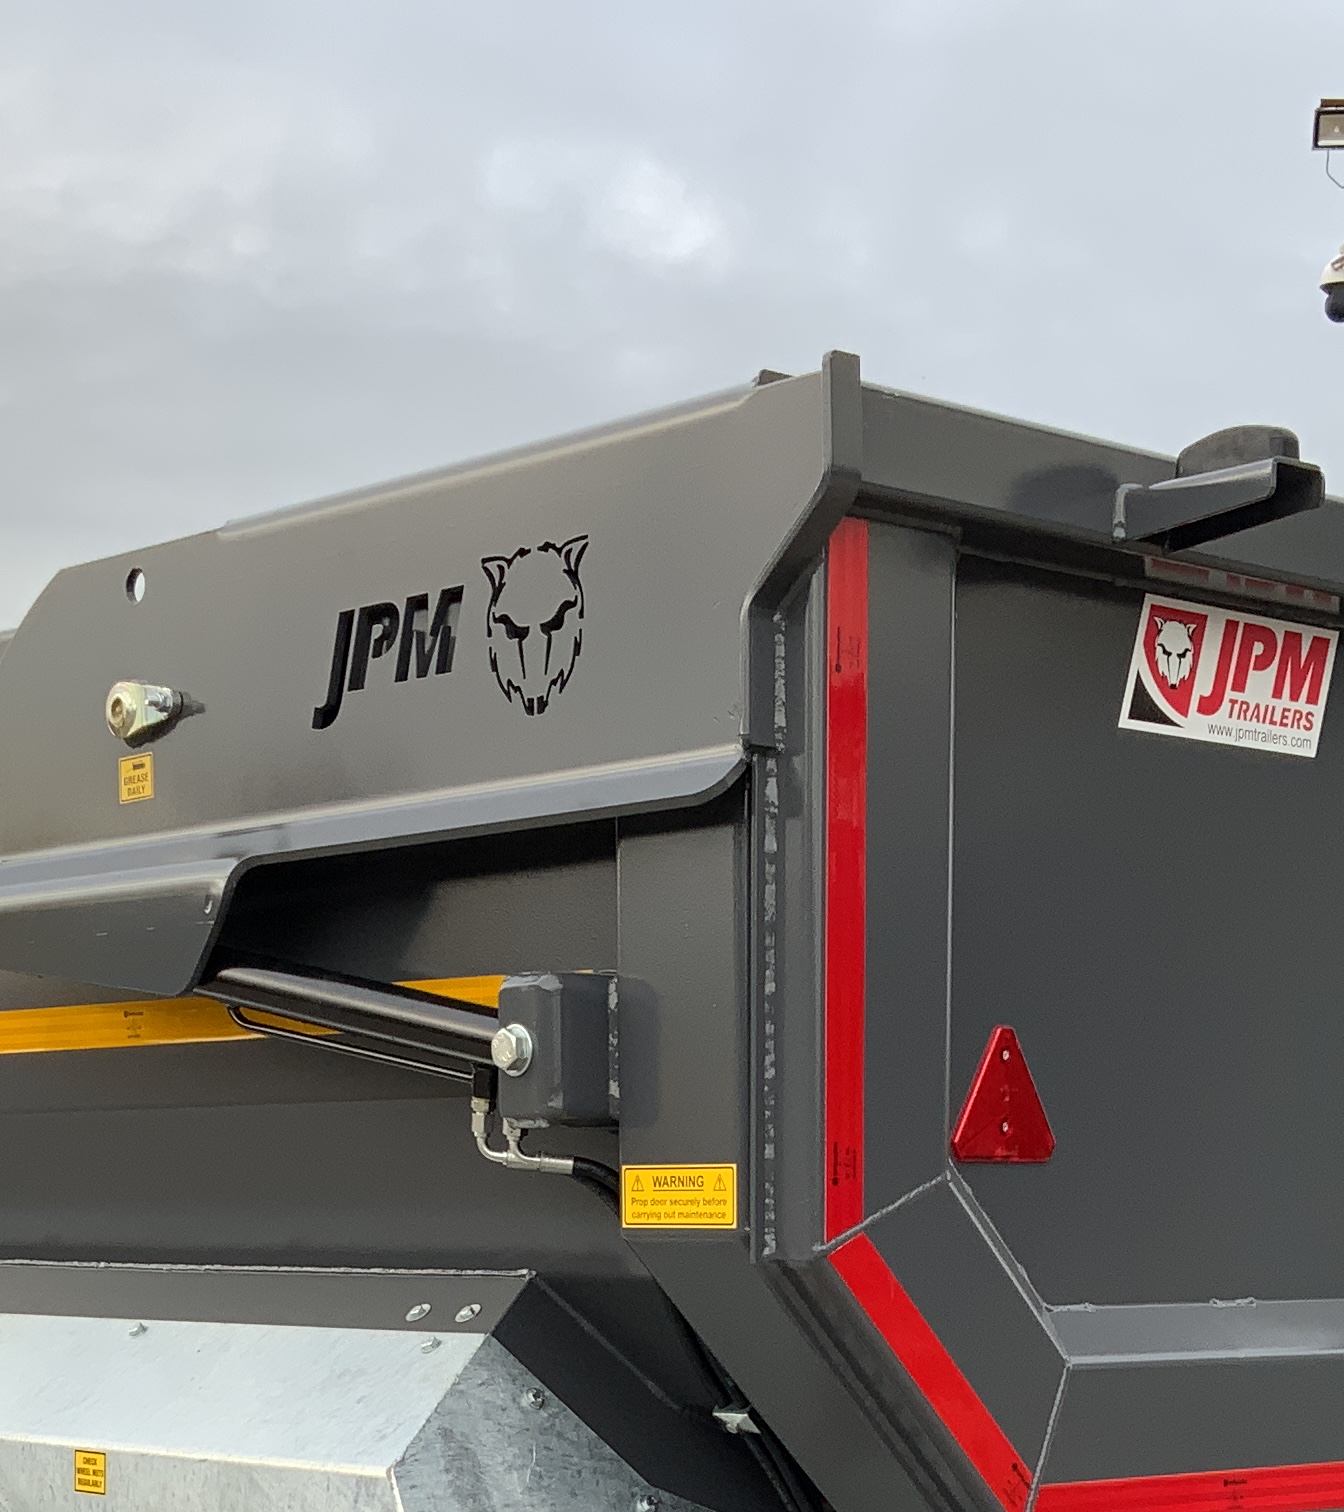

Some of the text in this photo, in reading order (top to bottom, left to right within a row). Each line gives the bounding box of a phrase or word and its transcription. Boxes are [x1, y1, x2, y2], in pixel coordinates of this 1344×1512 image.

[312, 584, 464, 730] JPM
[1196, 619, 1331, 716] JPM
[1228, 698, 1315, 732] TRAILERS
[1207, 723, 1312, 750] www.jpmtrailers.com
[652, 1175, 705, 1188] WARNING
[630, 1197, 728, 1208] Prop door securely before
[631, 1210, 727, 1221] carrying out maintenance
